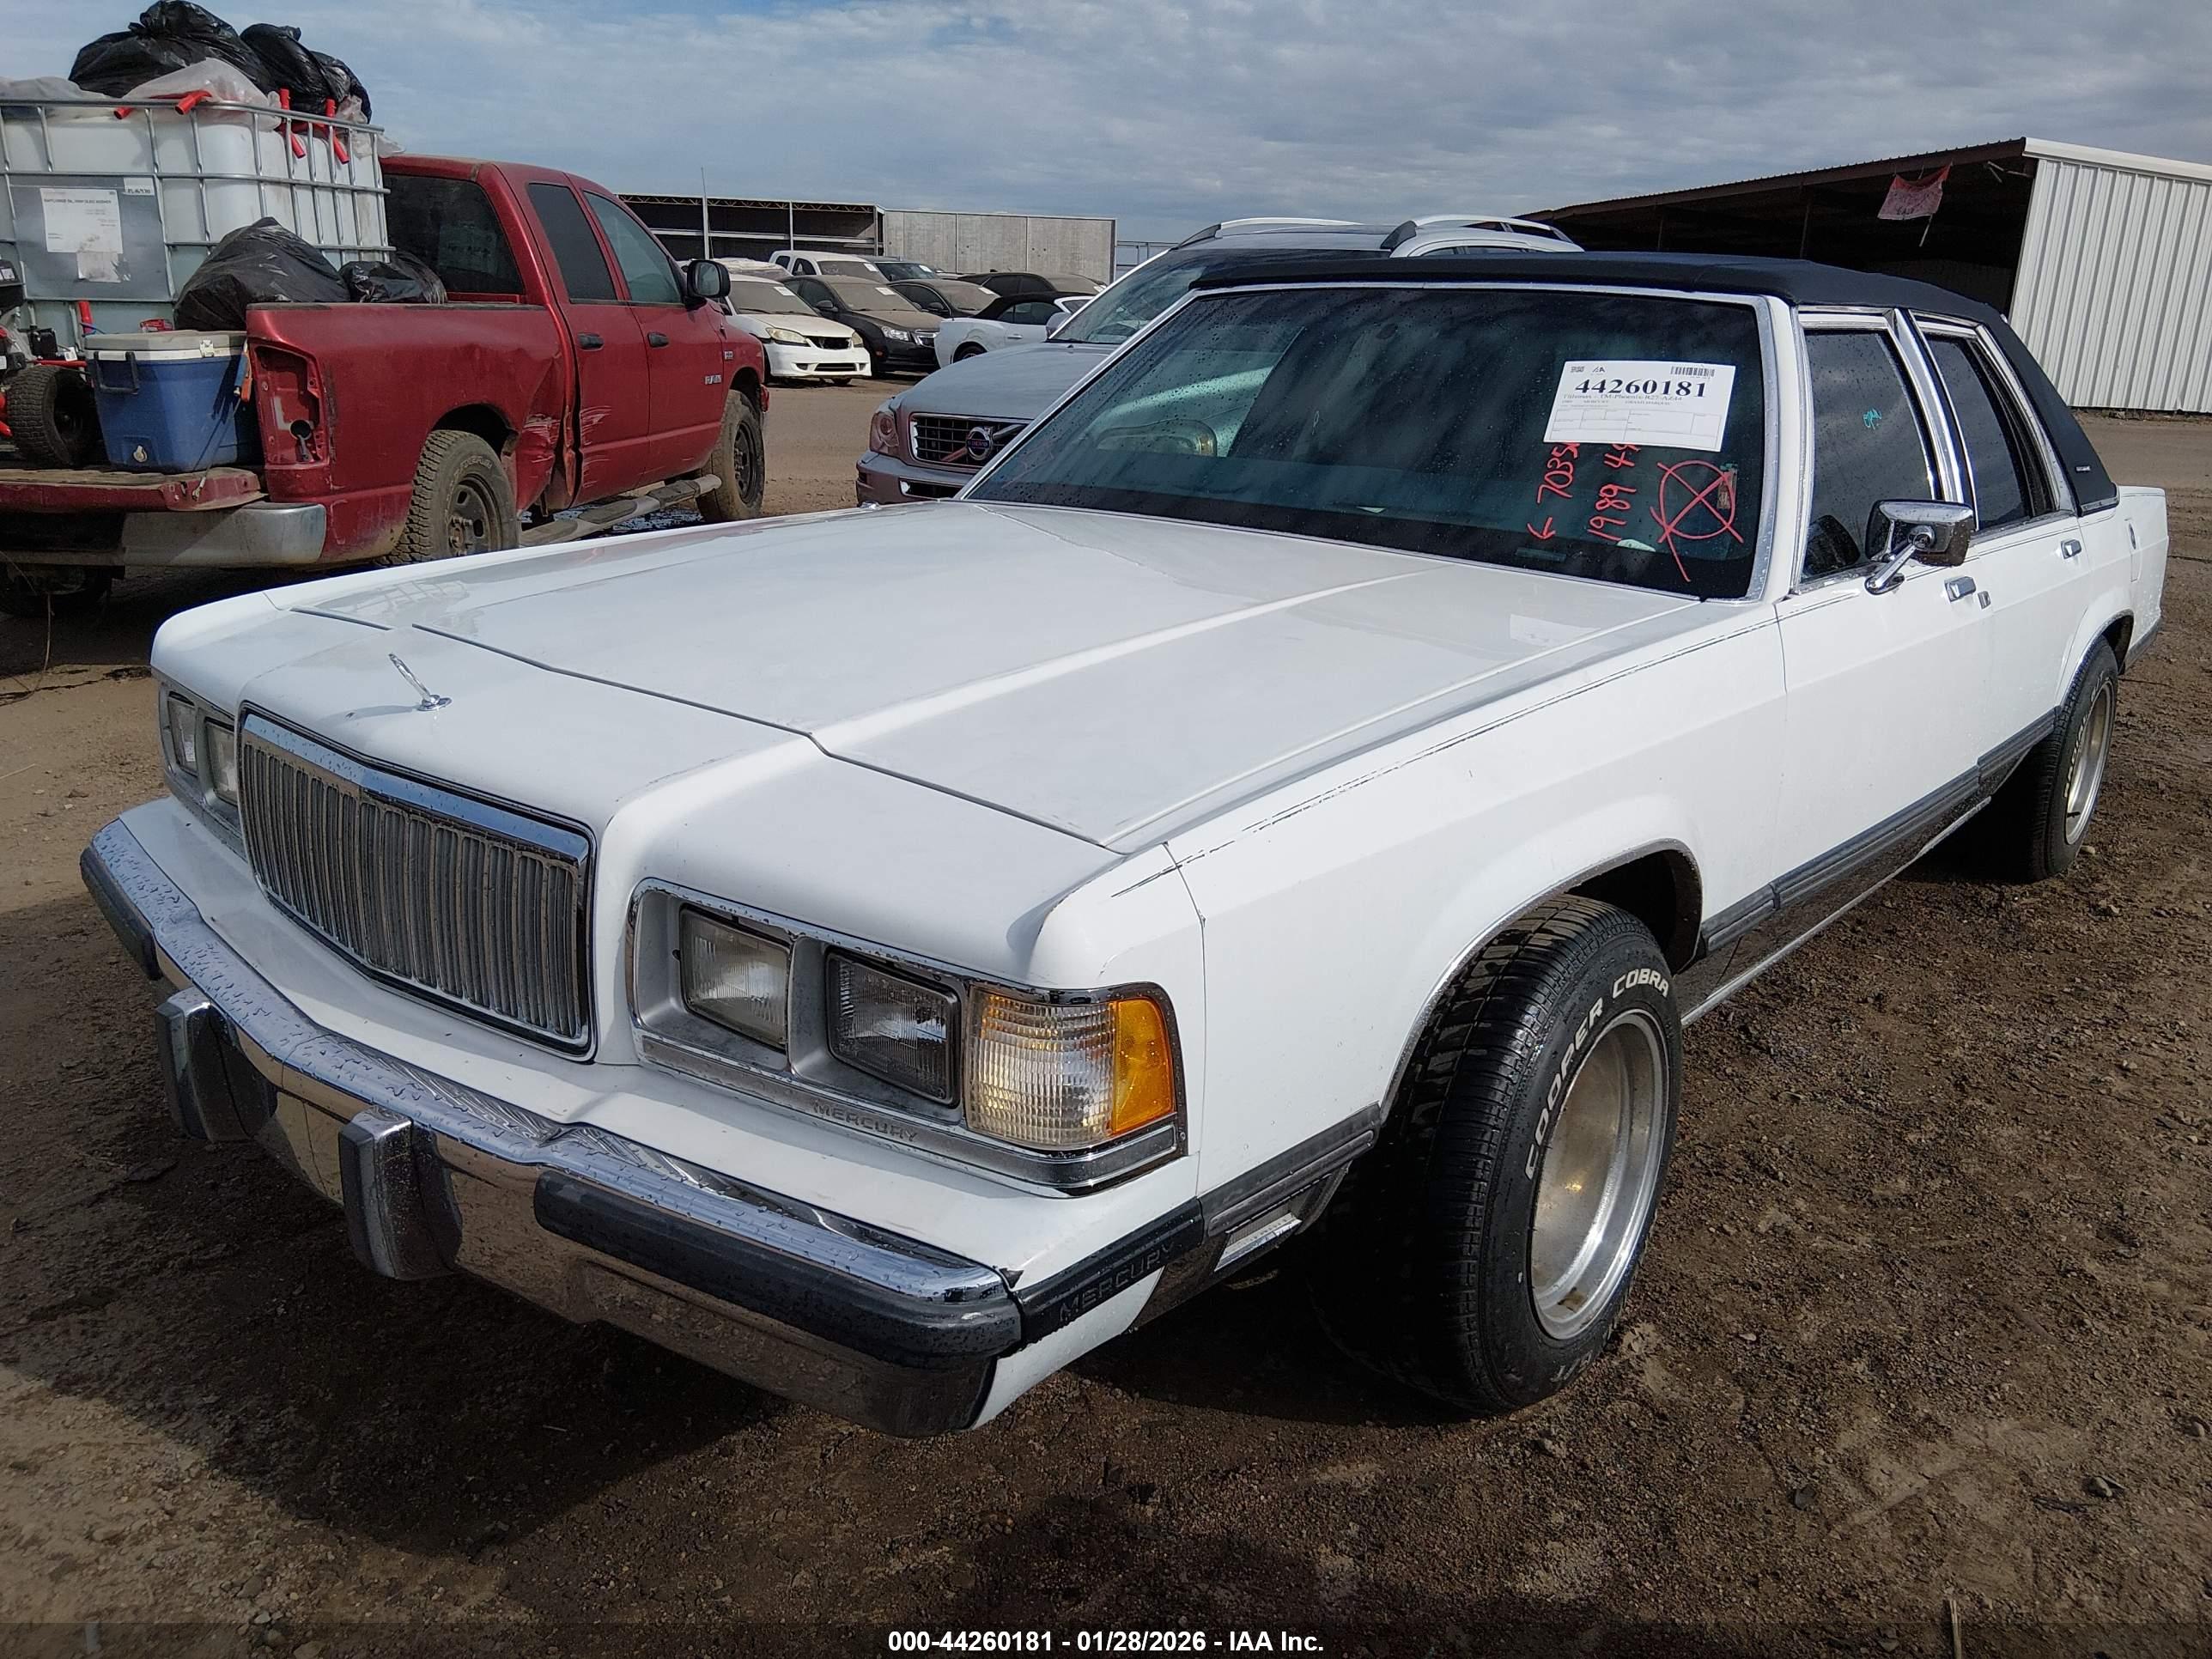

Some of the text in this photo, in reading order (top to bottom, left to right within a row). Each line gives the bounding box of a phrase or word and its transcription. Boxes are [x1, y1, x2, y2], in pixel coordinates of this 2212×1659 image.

[1575, 379, 1707, 398] 44260181
[1586, 483, 1637, 542] 1989
[1524, 966, 1670, 1182] COOPER COBRA
[811, 1100, 918, 1142] MERCURY
[1059, 1242, 1175, 1322] MERCURY
